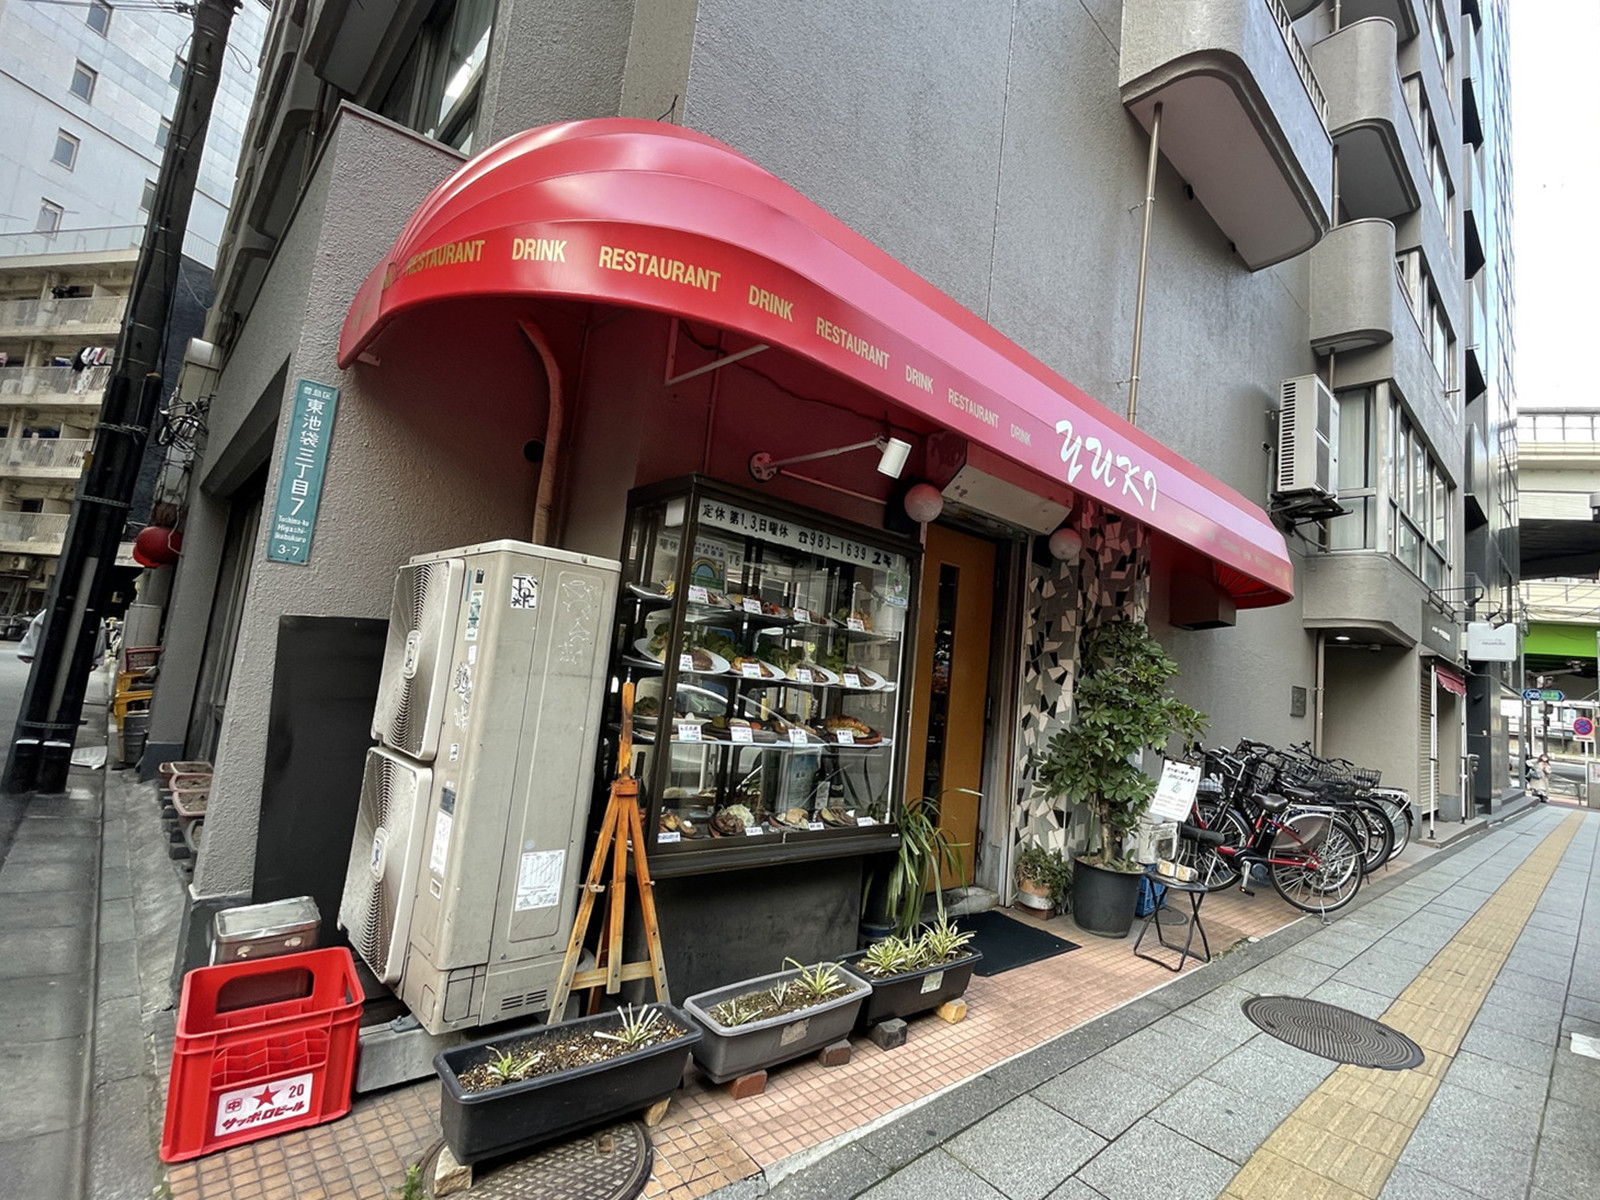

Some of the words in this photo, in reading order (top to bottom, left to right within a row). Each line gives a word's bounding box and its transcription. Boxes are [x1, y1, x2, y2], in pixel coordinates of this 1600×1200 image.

[511, 238, 568, 263] DRINK
[598, 246, 721, 292] RESTAURANT
[748, 285, 794, 322] DRINK
[815, 316, 890, 370] RESTAURANT
[905, 364, 934, 394] DRINK
[947, 387, 999, 429] RESTAURANT
[1010, 422, 1032, 447] DRINK
[277, 544, 300, 556] 3-7
[289, 1084, 304, 1098] 20
[222, 1101, 304, 1130] サッポロビール
